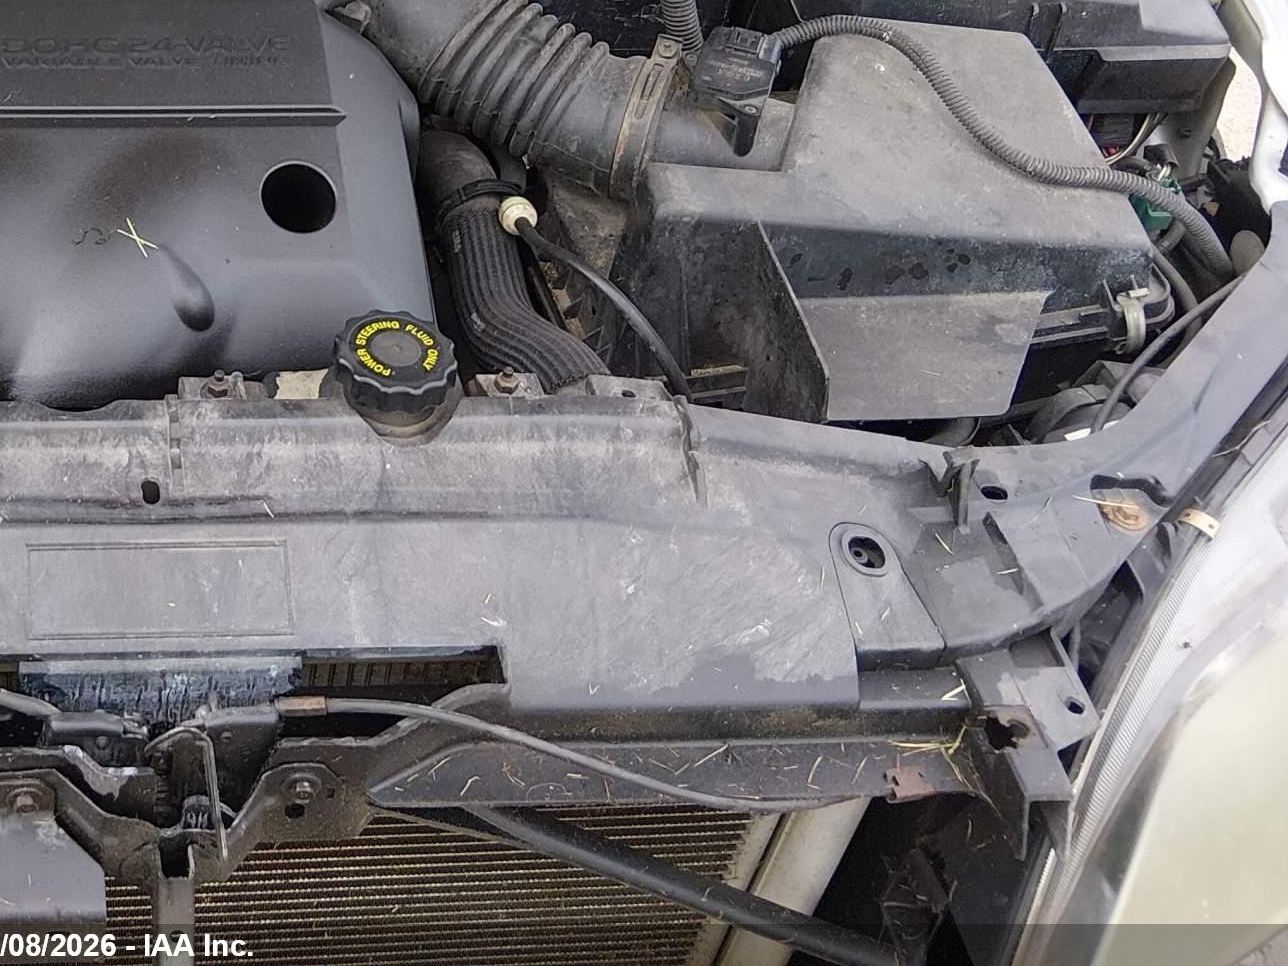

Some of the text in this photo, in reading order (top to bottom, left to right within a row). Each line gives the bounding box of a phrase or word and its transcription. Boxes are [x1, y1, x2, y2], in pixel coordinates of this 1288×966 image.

[355, 321, 438, 376] POWER STEERING FLUID ONLY
